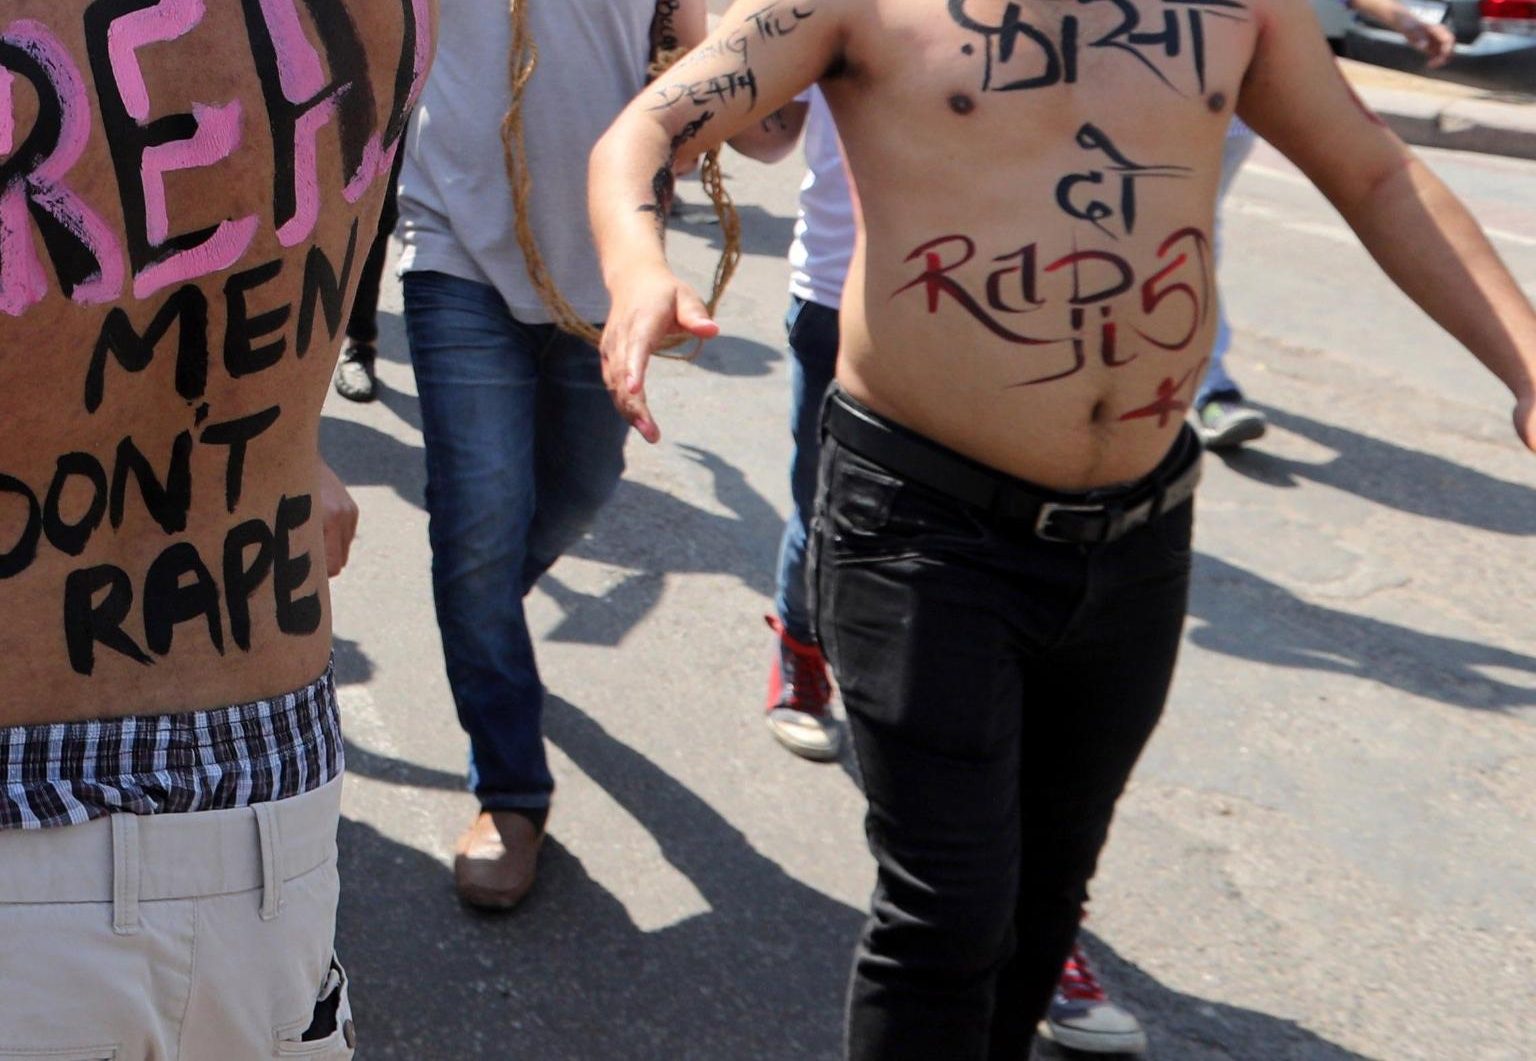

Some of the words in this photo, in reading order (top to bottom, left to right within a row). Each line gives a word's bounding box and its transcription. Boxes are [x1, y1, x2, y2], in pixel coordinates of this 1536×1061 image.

[644, 66, 760, 117] DEATH
[1055, 122, 1194, 241] दो
[84, 215, 359, 414] MEN
[63, 493, 323, 677] RAPE
